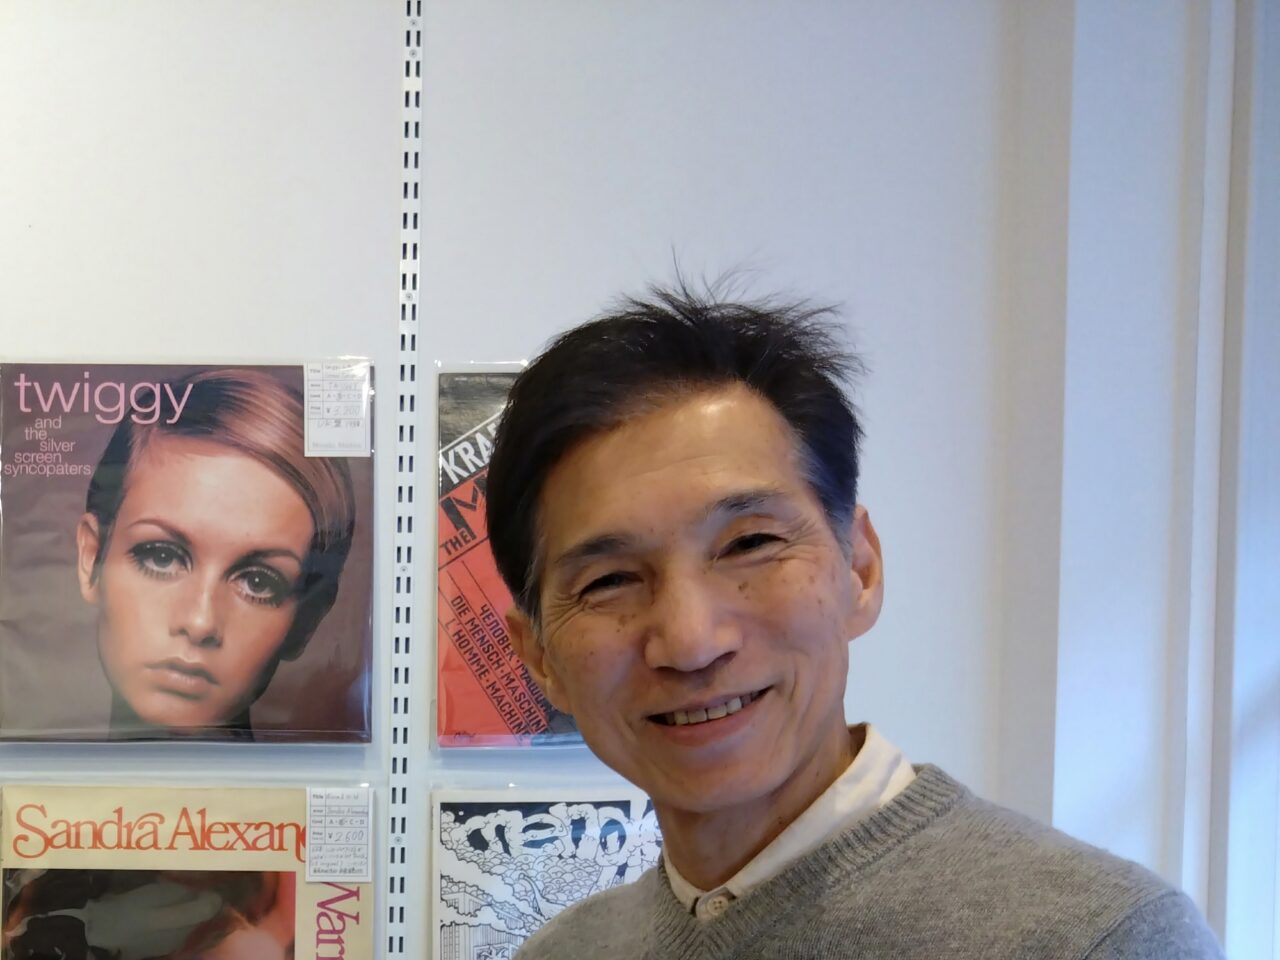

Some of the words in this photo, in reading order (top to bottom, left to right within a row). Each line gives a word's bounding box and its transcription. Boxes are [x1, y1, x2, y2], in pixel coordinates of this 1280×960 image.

[14, 371, 194, 425] twiggy
[34, 416, 62, 430] and
[25, 427, 48, 441] the
[40, 438, 76, 452] silver
[14, 452, 62, 464] screen
[4, 462, 91, 477] syncopaters
[439, 529, 471, 556] THE
[451, 595, 471, 618] DIE
[465, 617, 505, 671] MENSCH
[12, 803, 166, 859] Sandra
[167, 806, 306, 863] Alexan
